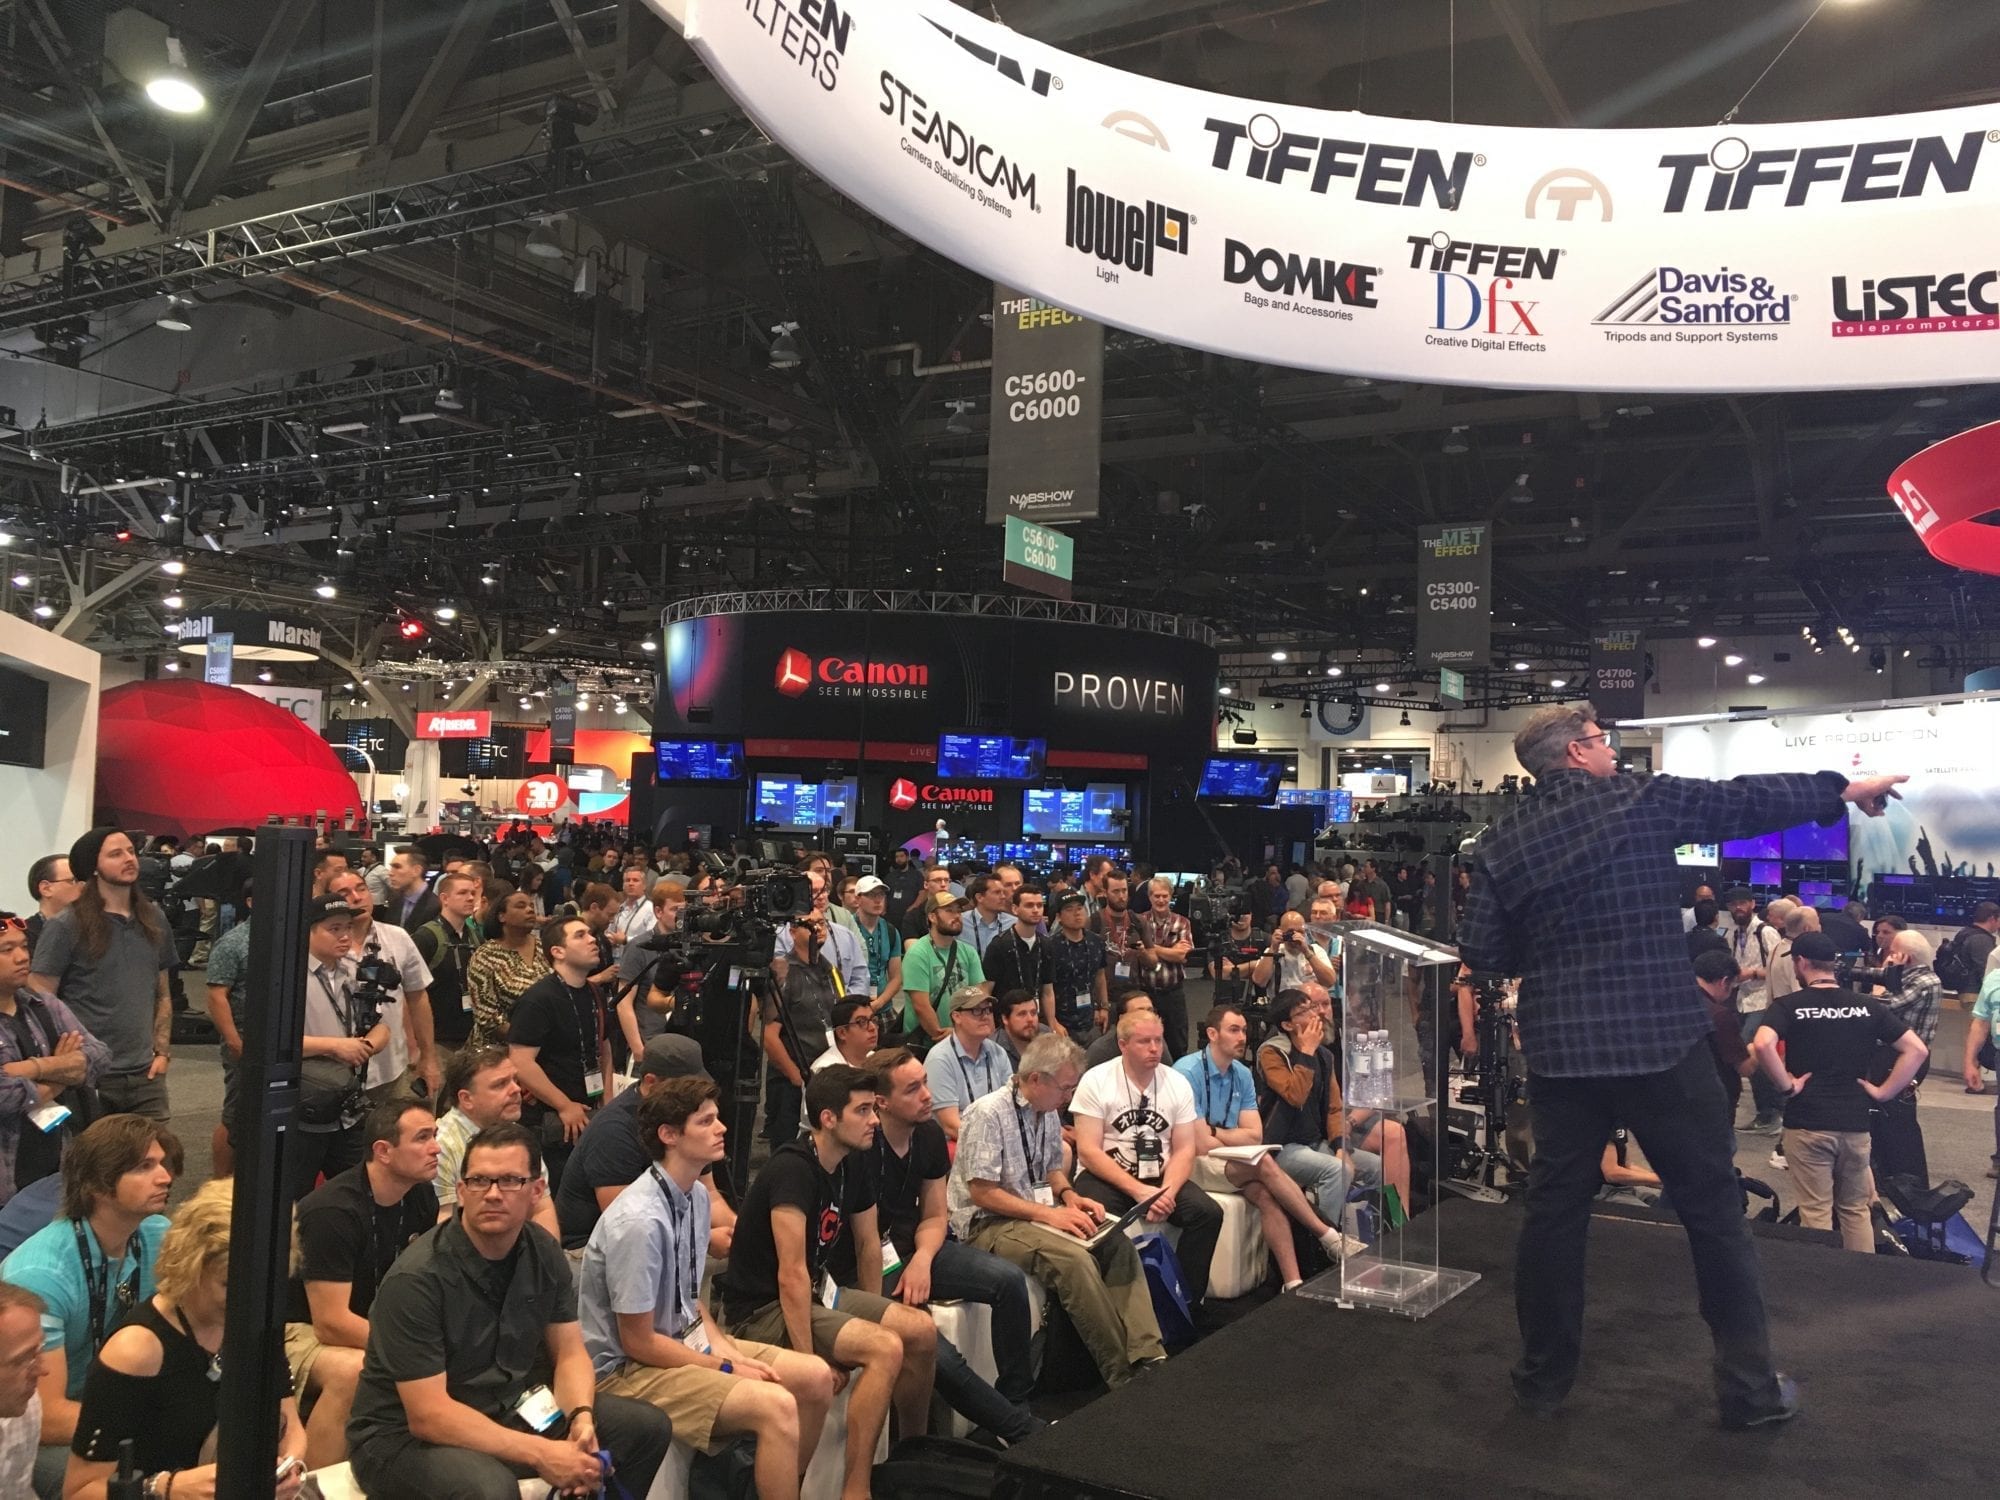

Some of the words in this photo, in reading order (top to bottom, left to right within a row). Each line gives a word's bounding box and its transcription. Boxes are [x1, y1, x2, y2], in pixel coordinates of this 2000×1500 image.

[880, 70, 1035, 210] STEADICAM
[901, 137, 932, 169] Camera
[934, 160, 975, 199] Stabilizing
[977, 189, 1012, 218] Systems
[1066, 167, 1155, 277] lowel
[1096, 266, 1119, 284] Light
[1224, 238, 1378, 308] DOMKE
[1001, 299, 1030, 315] THE
[1244, 292, 1270, 308] Bags
[1271, 299, 1291, 312] and
[1293, 302, 1354, 321] Accessories
[1428, 272, 1543, 336] Dfx
[1660, 295, 1790, 323] Sanford
[1019, 309, 1082, 330] EFFEC
[1836, 318, 1995, 334] teleprompters
[1425, 334, 1468, 347] Creative
[1471, 338, 1505, 351] Digital
[1508, 341, 1546, 352] Effects
[1604, 331, 1647, 343] Tripods
[1650, 331, 1672, 342] and
[1675, 331, 1722, 344] Support
[1726, 331, 1778, 344] Systems
[1004, 369, 1085, 396] C5600-
[1010, 395, 1081, 422] C6000
[1422, 539, 1442, 548] THE
[1442, 527, 1485, 546] MET
[1024, 546, 1056, 571] C6000
[1435, 545, 1480, 557] EFFECT
[1426, 581, 1480, 595] C5300-
[1430, 596, 1477, 610] C5400
[818, 656, 929, 686] Canon
[1596, 669, 1637, 679] C4700-
[818, 686, 841, 696] SEE
[847, 688, 928, 699] IMOSSIBLE
[1054, 671, 1184, 716] PROVEN
[1600, 679, 1635, 689] C5100
[1785, 736, 1817, 748] LIVE
[1824, 728, 1939, 744] PRODUCON
[526, 780, 559, 801] 30
[921, 784, 994, 803] Canon
[921, 802, 937, 810] SEE
[1795, 1006, 1870, 1019] STEADICAM
[1118, 1111, 1164, 1130] オリナル
